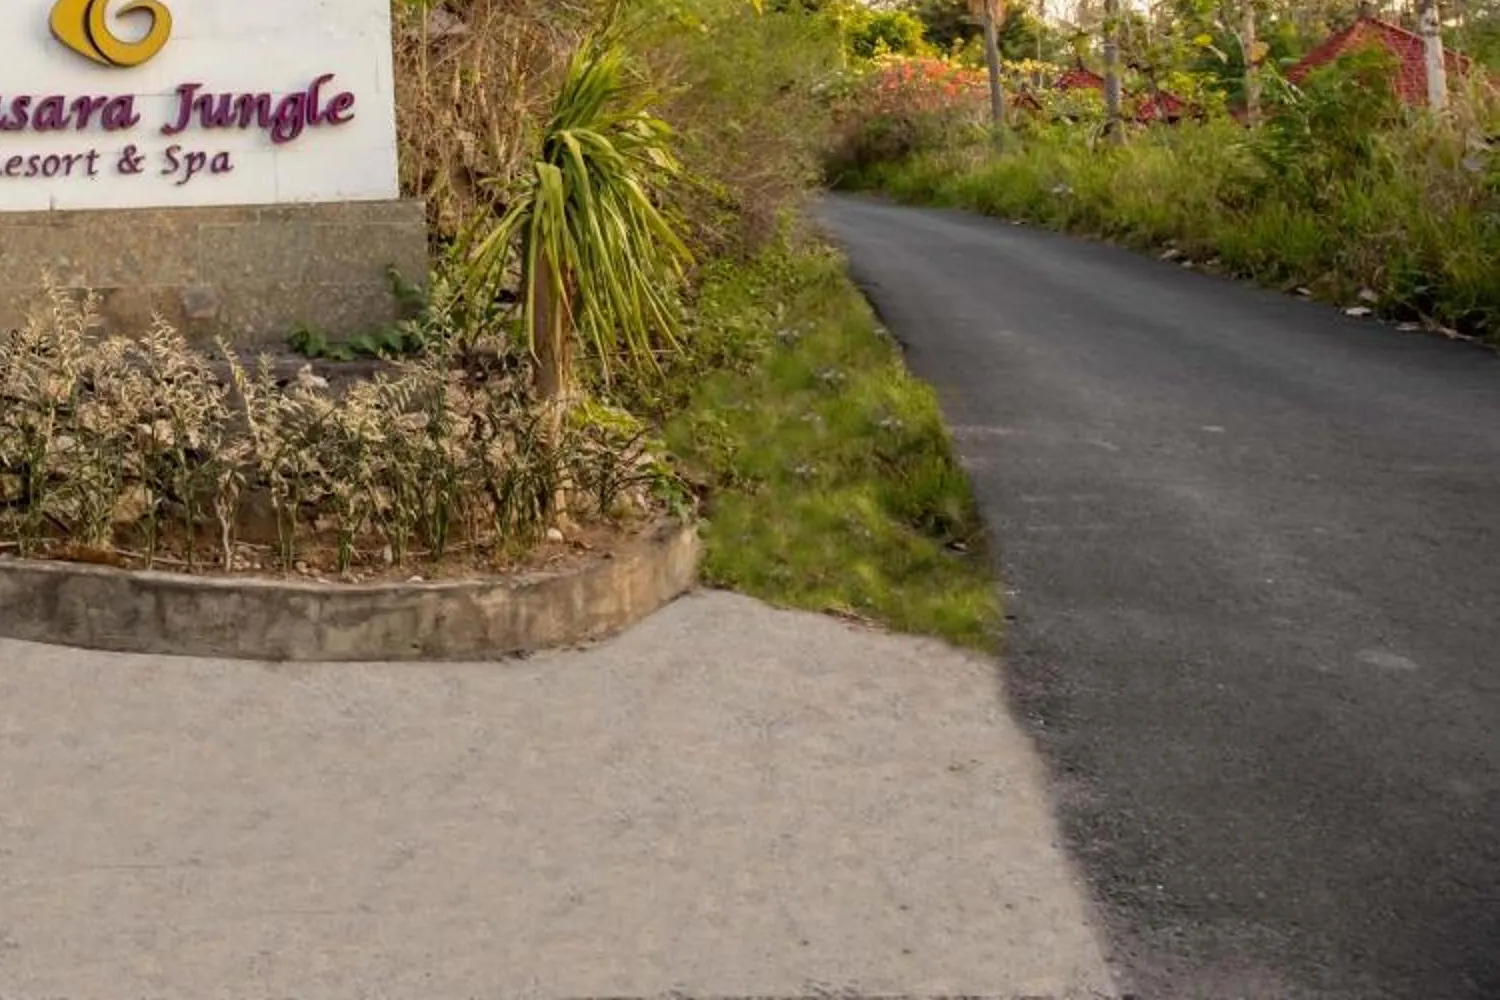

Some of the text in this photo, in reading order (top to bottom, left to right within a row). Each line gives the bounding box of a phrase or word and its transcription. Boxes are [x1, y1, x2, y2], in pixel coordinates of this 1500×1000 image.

[160, 73, 357, 145] Jungle
[116, 144, 145, 175] &
[160, 144, 235, 186] Spa
